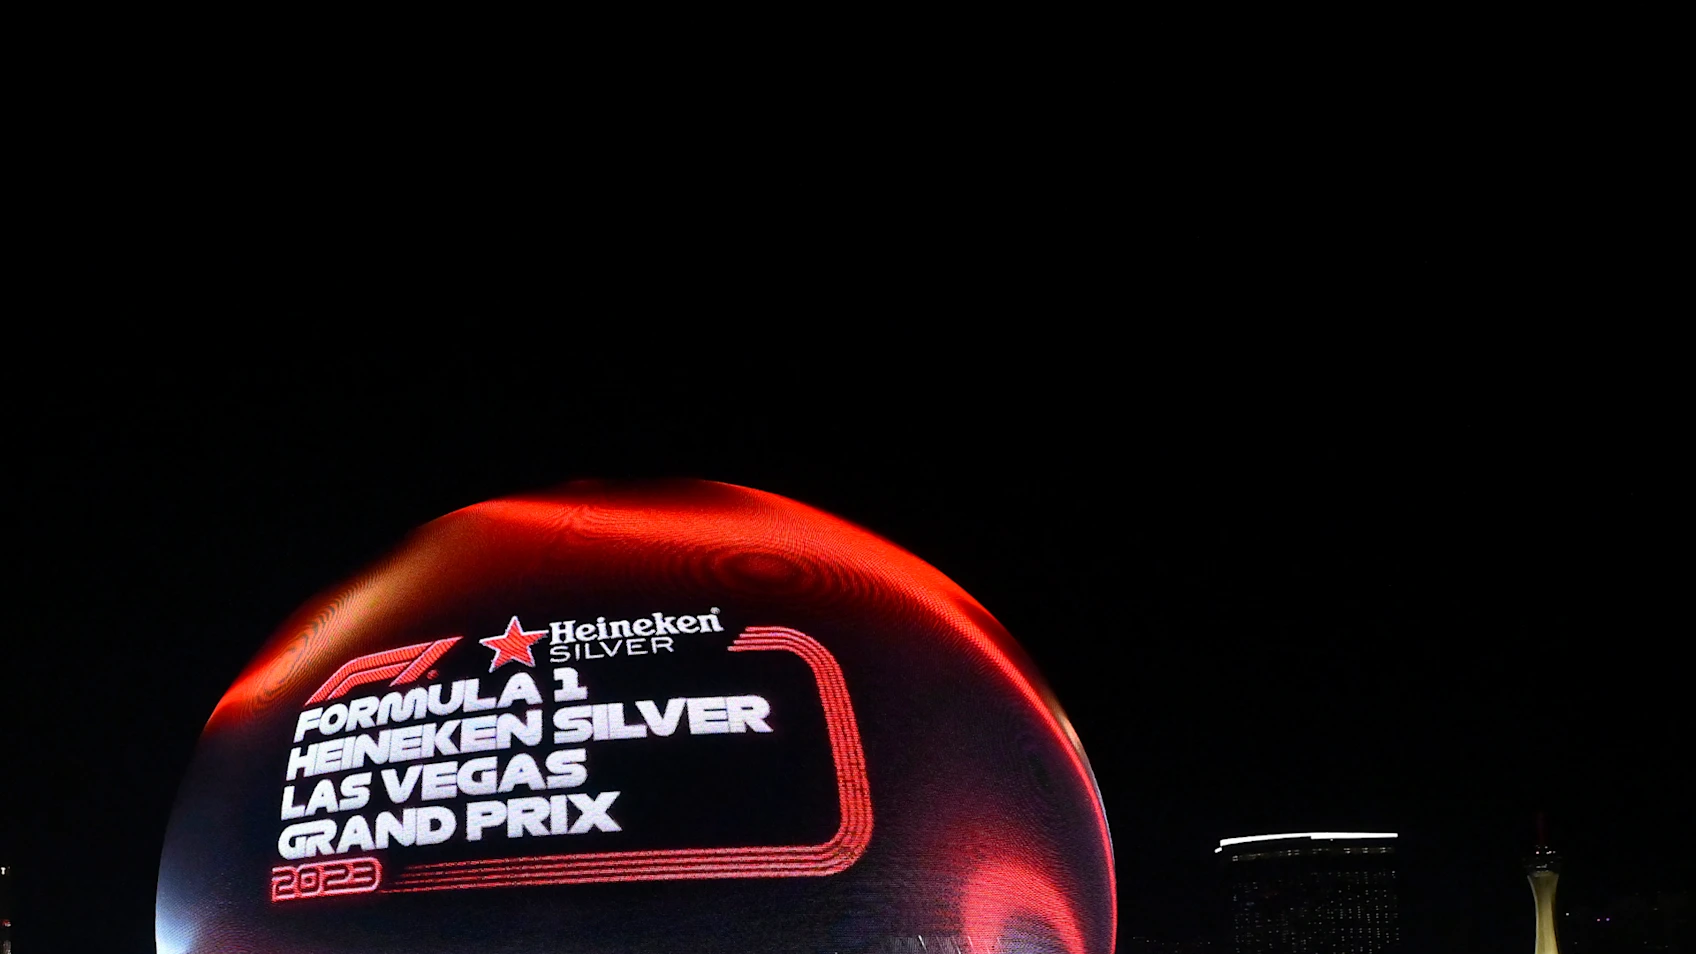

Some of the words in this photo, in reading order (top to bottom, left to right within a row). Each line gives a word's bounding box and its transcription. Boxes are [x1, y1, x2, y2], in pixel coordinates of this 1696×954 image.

[549, 612, 724, 645] Heineken
[549, 637, 675, 663] SILVER
[286, 709, 543, 780] HEINEKEN
[553, 695, 773, 744] SILVER
[293, 673, 543, 743] FORMULA
[554, 668, 588, 700] 1
[280, 773, 371, 820] LAS
[381, 749, 587, 804] VEGAS
[277, 806, 456, 860] GRAND
[466, 791, 622, 842] PRIX
[272, 858, 382, 901] 2023
